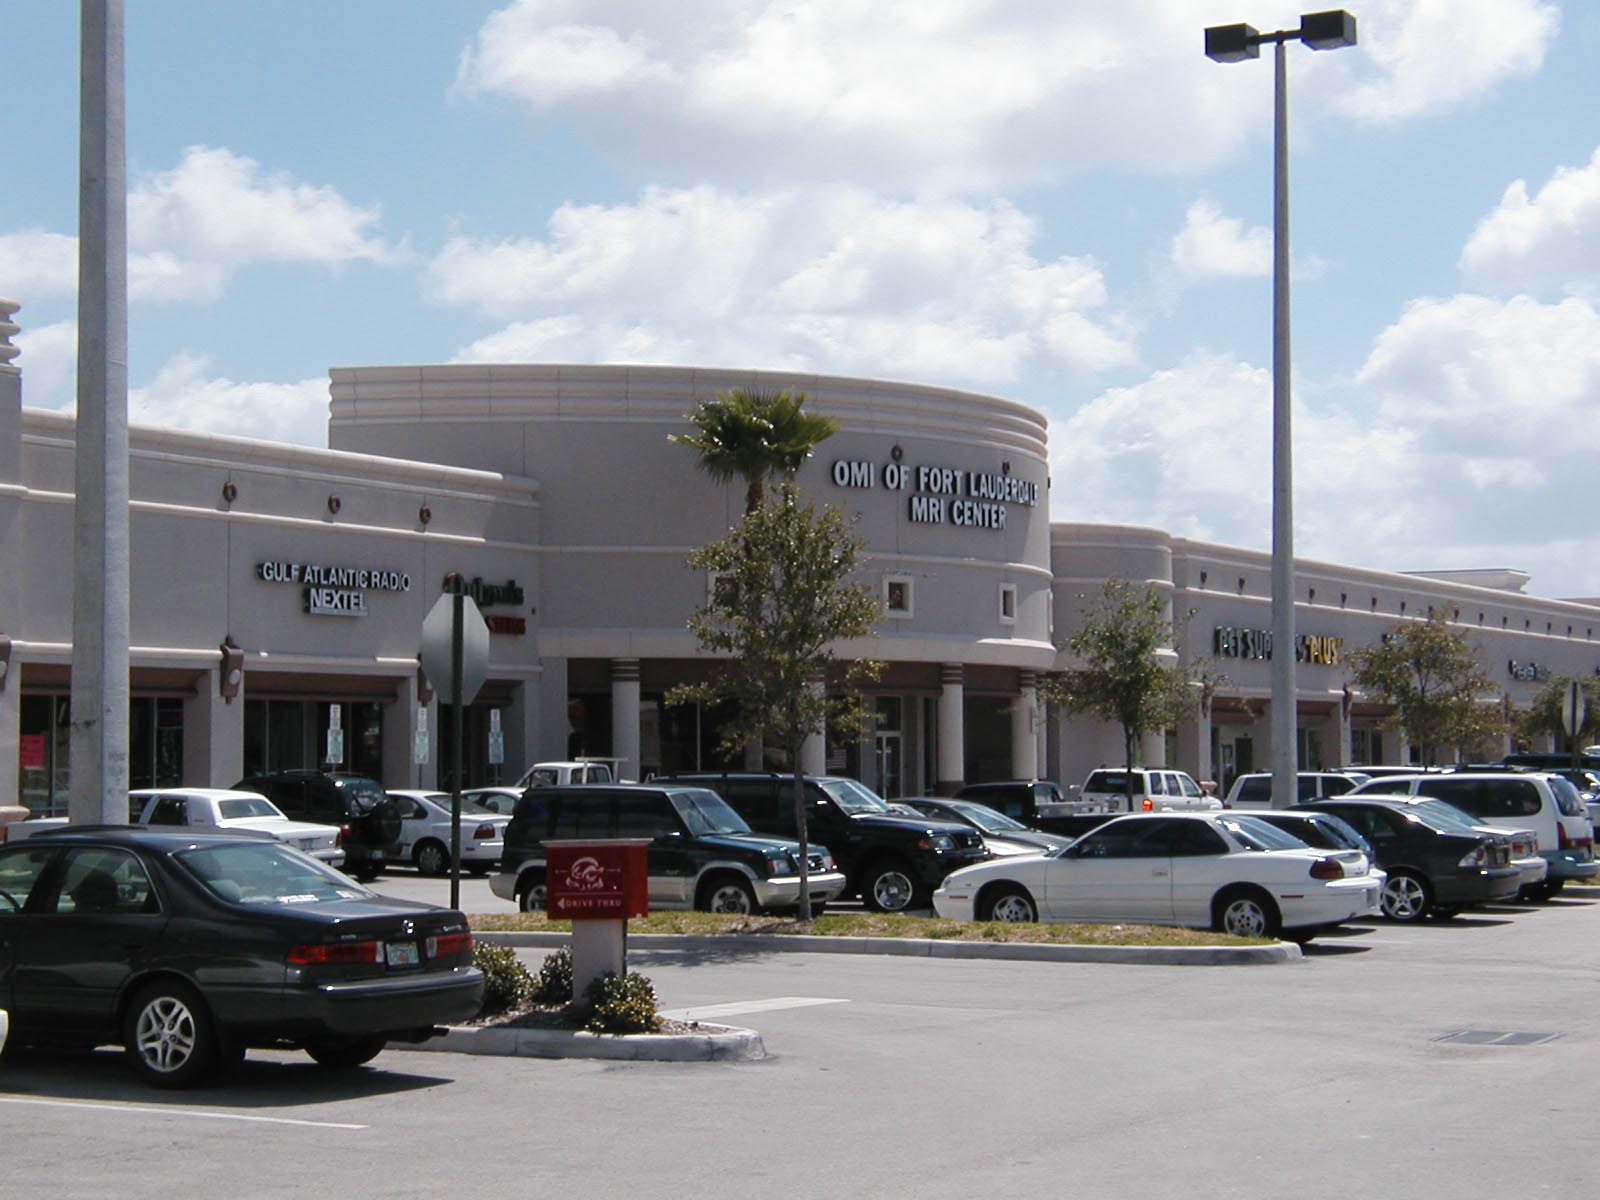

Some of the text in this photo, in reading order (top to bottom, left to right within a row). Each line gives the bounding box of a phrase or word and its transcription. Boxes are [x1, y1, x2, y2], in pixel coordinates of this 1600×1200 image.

[833, 460, 1040, 508] OMI OF FORT LAUDERDALE
[911, 496, 1008, 529] MRI CENTER
[262, 562, 412, 592] GULF ATLANTIC RADIO
[309, 587, 366, 610] NEXTEL
[1216, 625, 1243, 657] PET
[565, 898, 622, 908] DRIVE THRU
